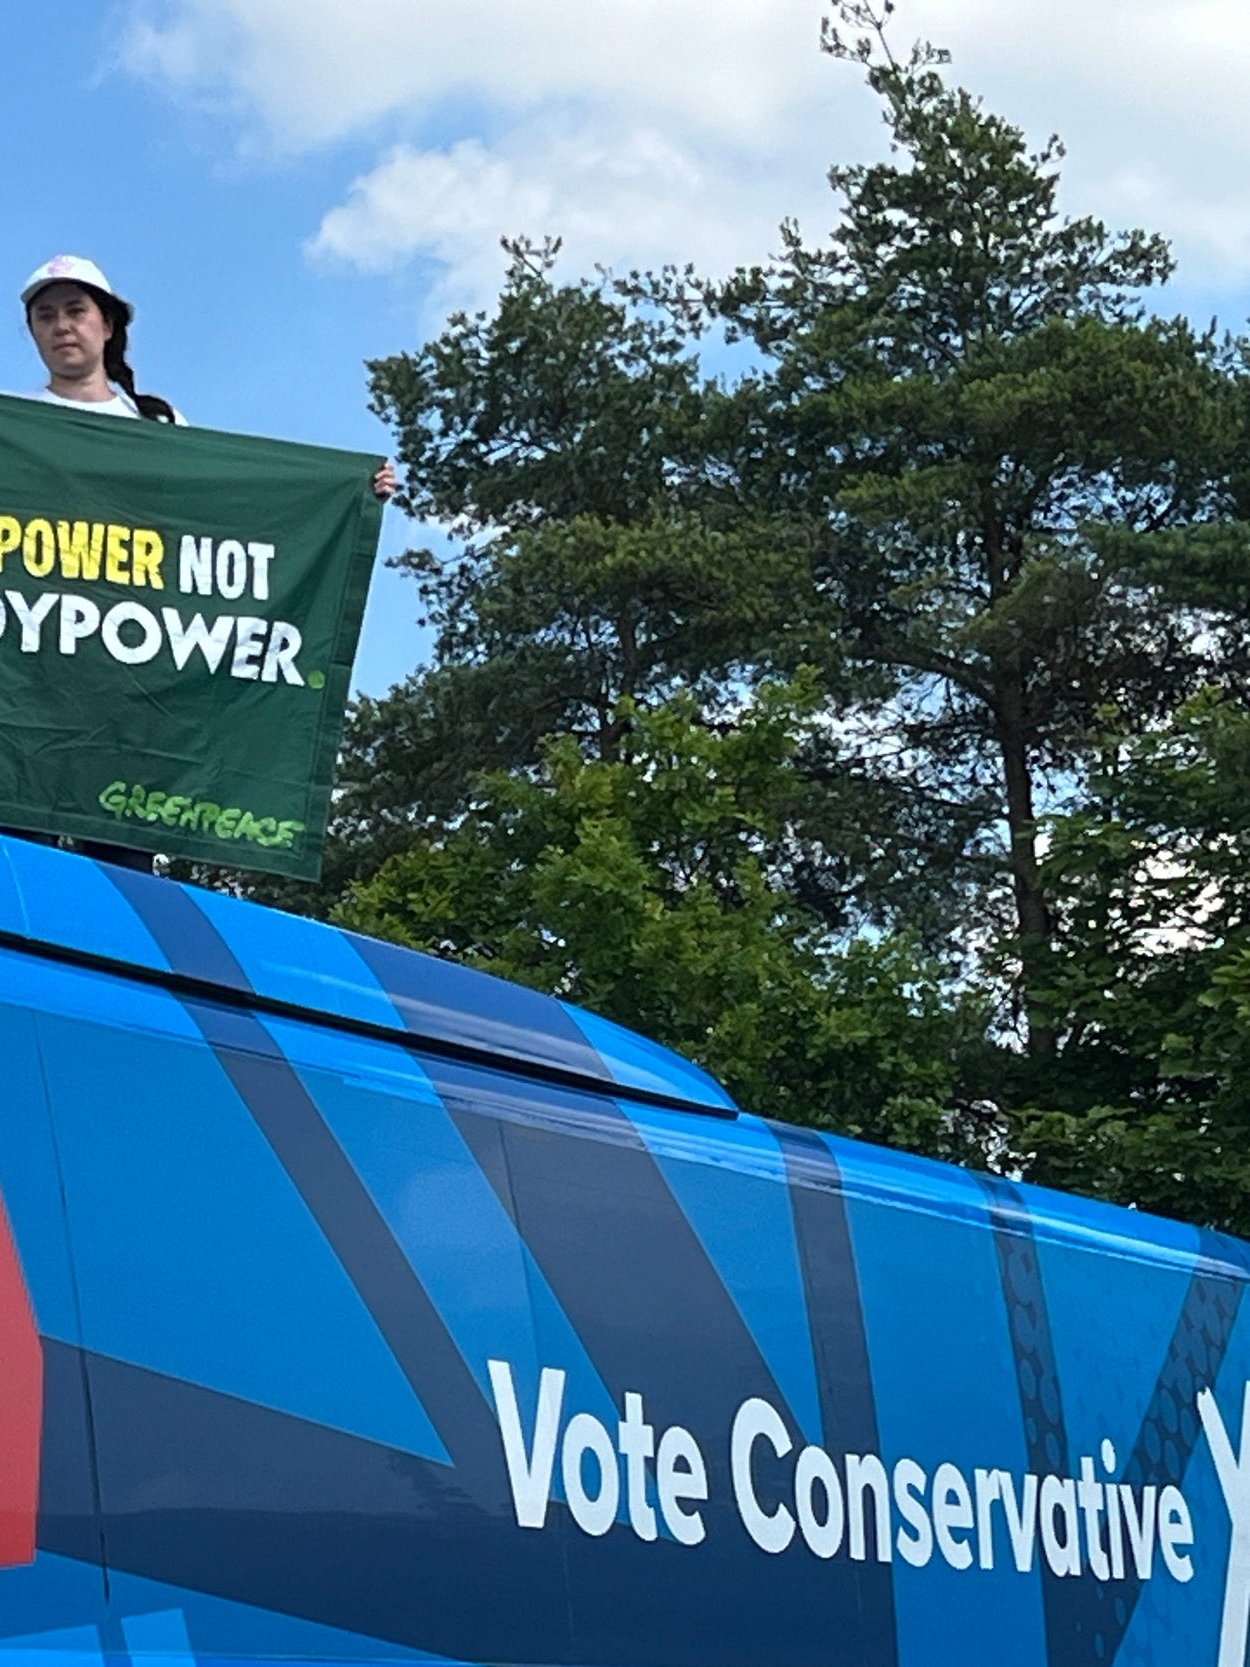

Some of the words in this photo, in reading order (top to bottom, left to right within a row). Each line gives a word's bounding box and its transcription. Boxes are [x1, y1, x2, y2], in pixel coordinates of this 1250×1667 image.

[178, 534, 276, 601] NOT
[98, 781, 306, 849] GREENPEACE
[487, 1359, 708, 1546] Vote
[730, 1397, 1194, 1582] Conservative
